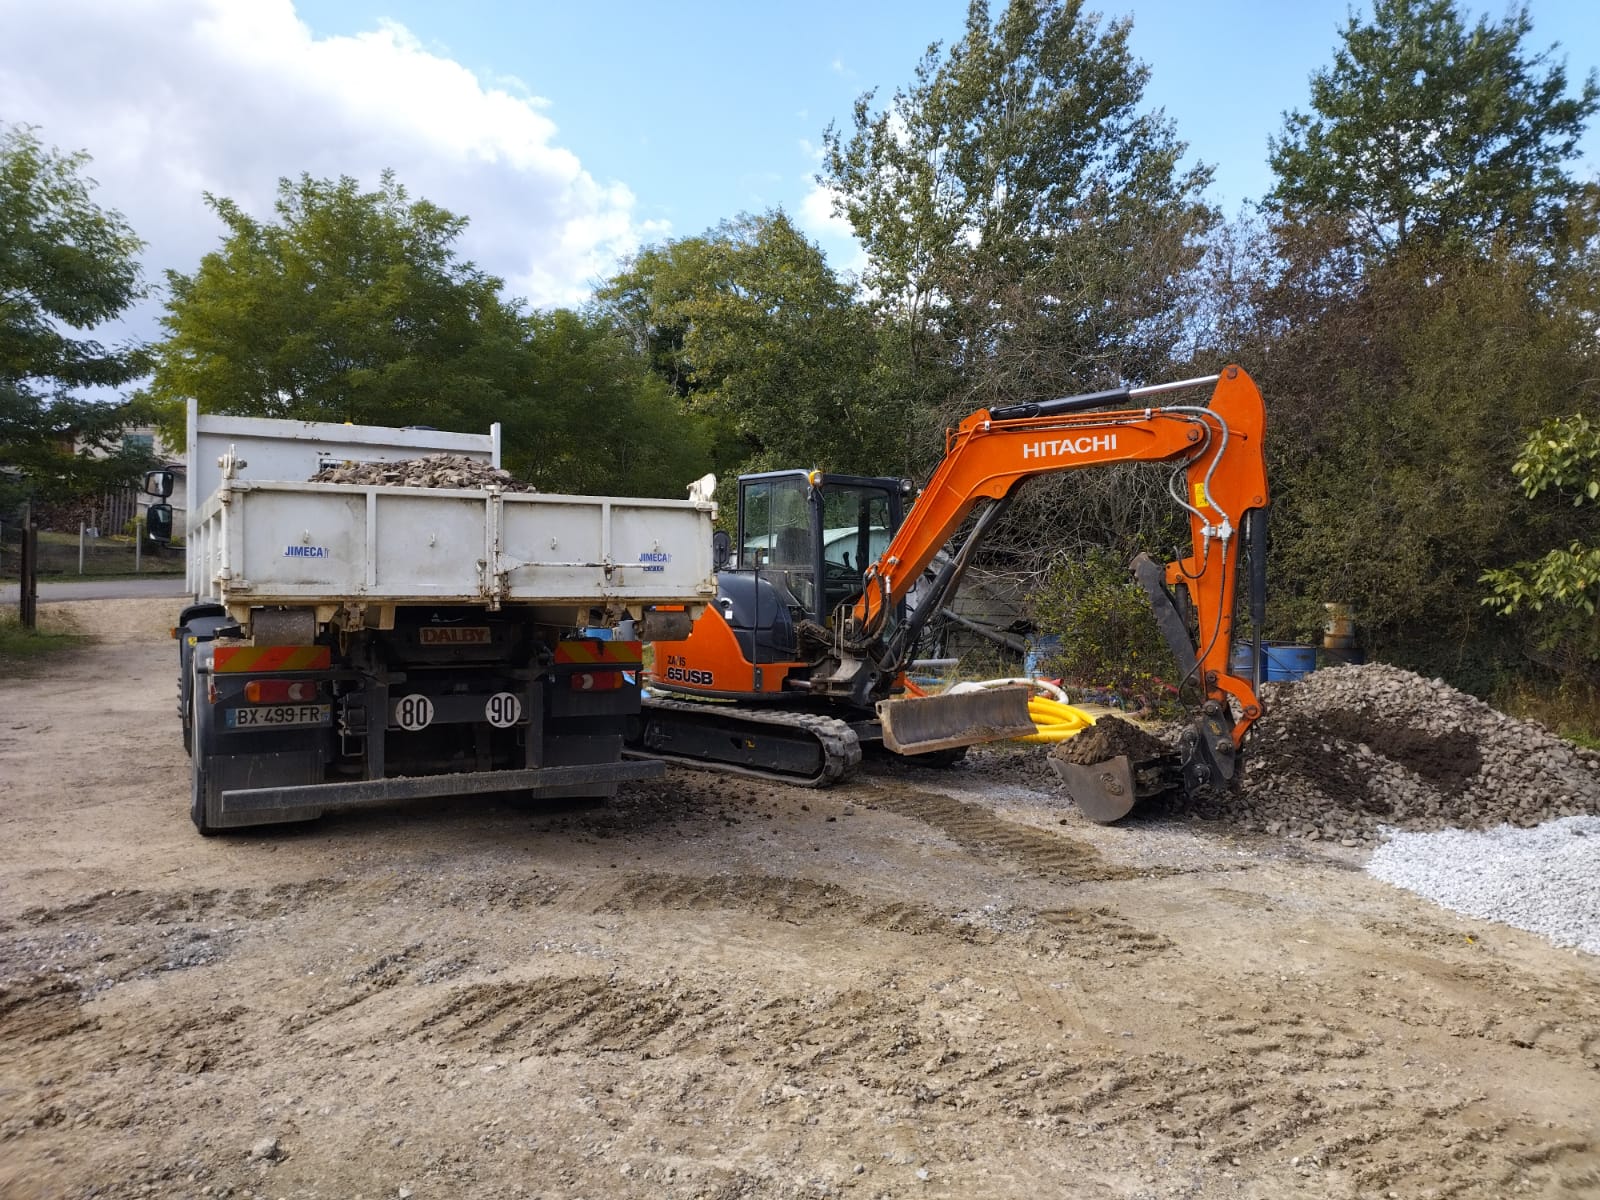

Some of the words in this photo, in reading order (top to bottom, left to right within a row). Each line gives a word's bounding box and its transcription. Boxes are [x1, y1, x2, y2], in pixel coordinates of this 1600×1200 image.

[1023, 434, 1117, 459] HITACHI
[284, 546, 323, 557] JIMECA
[639, 553, 667, 562] JIMECA
[423, 629, 487, 641] DALBY
[667, 667, 713, 685] 65USB
[402, 698, 428, 726] 80
[491, 696, 515, 723] 90
